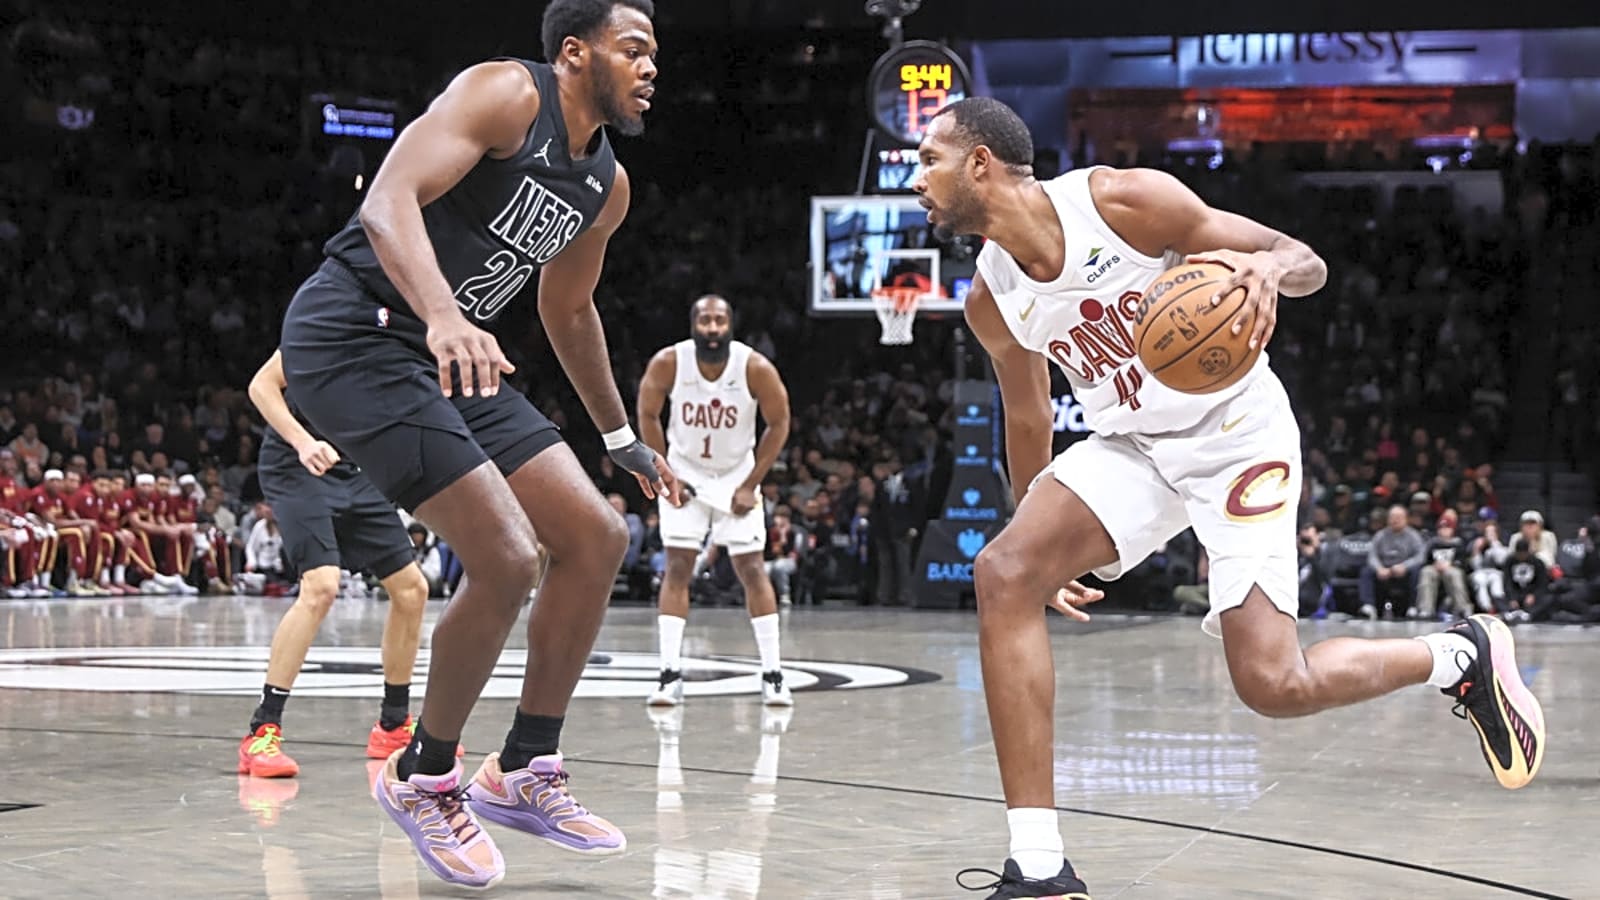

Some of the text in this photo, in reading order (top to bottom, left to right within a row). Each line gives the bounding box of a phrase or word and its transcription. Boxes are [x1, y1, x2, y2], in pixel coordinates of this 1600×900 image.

[488, 176, 583, 263] NETS
[1086, 255, 1121, 283] CLIFFS
[453, 250, 533, 320] 20
[1113, 364, 1143, 412] 4
[682, 402, 738, 429] CAVS
[701, 433, 712, 459] 1
[946, 508, 998, 520] BARCLAYS
